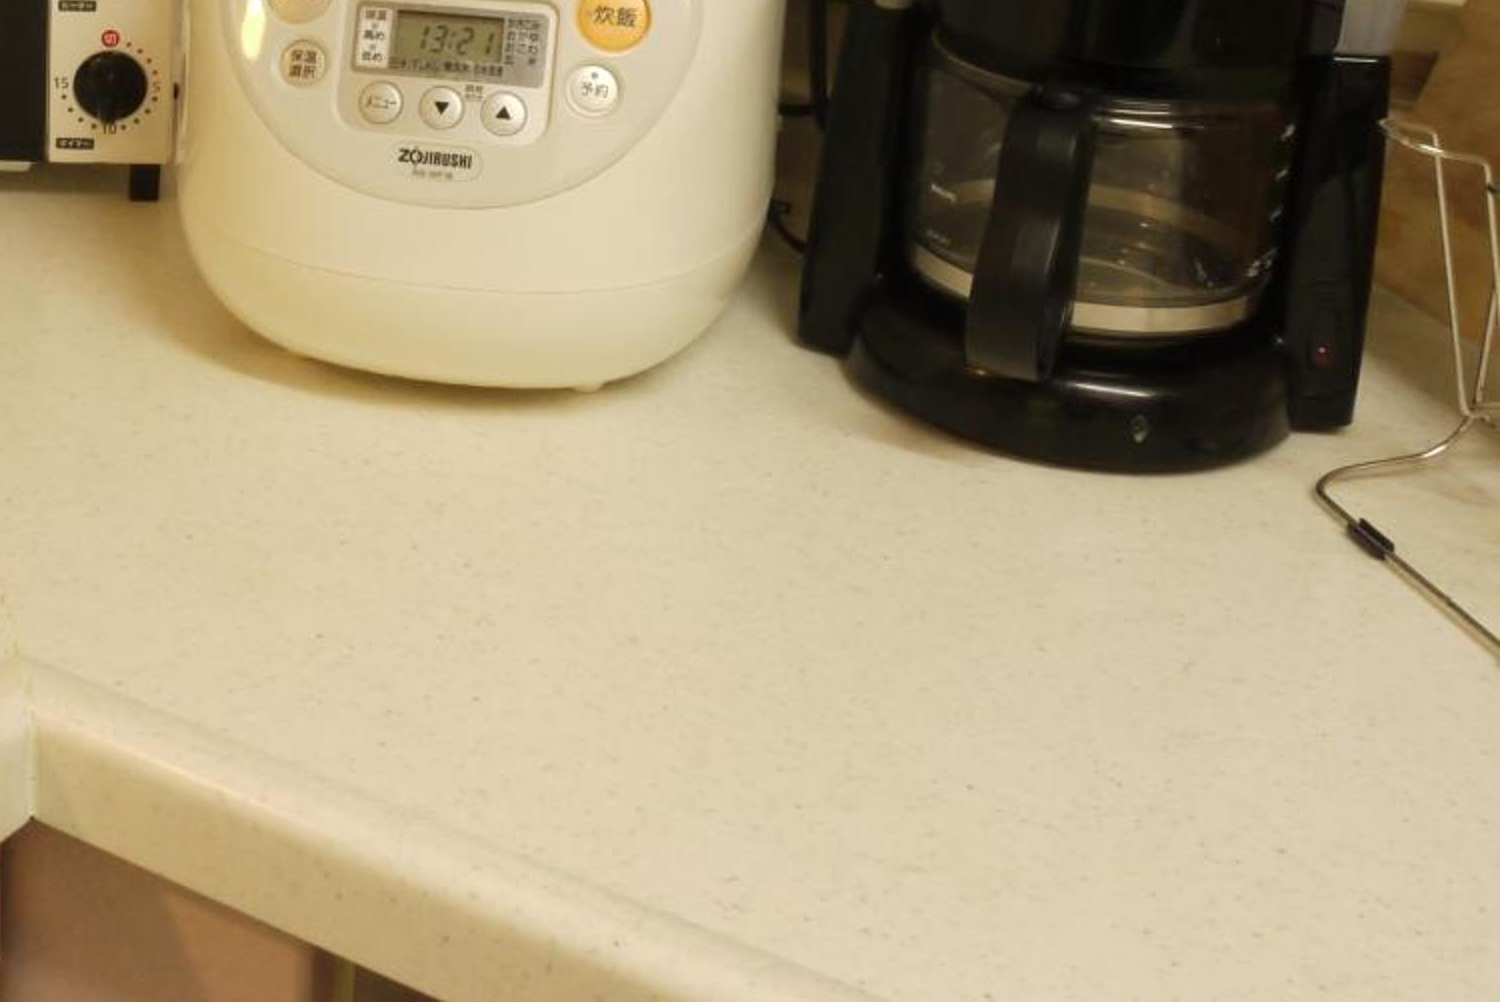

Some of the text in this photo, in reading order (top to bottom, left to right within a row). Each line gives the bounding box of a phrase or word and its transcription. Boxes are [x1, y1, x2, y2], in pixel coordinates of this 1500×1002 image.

[594, 5, 637, 27] 炊飯
[420, 25, 495, 55] 13:21
[54, 77, 68, 89] 15
[580, 83, 608, 98] 予約
[103, 123, 117, 135] 10
[398, 145, 472, 169] ZOJIRUSHI
